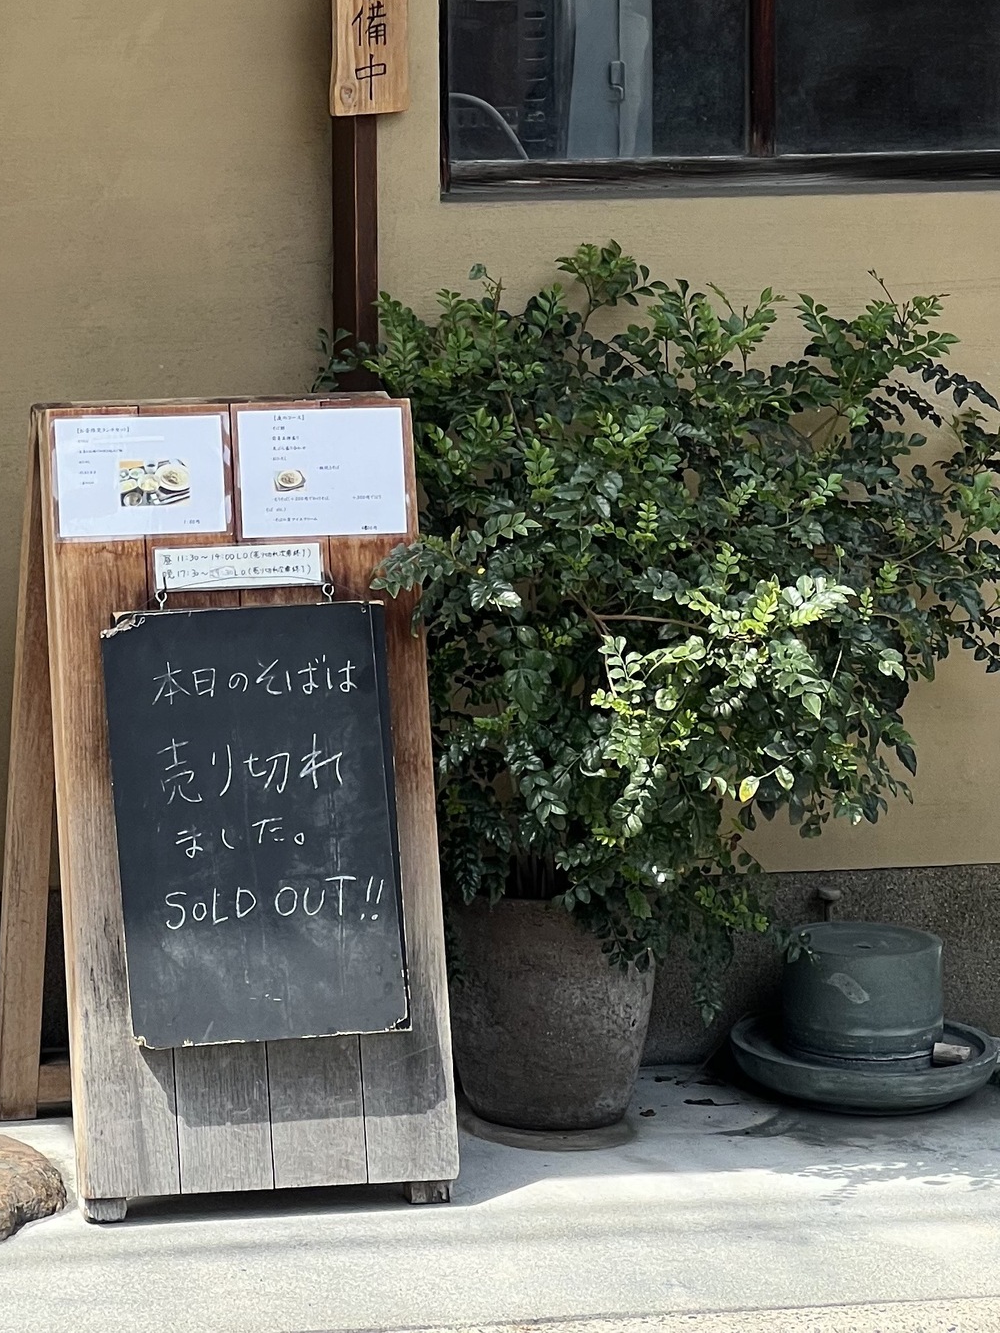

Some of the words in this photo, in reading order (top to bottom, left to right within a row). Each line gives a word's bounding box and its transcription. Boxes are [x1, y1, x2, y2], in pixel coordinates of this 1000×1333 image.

[151, 654, 359, 706] 本日のそばは
[157, 733, 345, 805] 売り切れ
[174, 817, 307, 859] ました。
